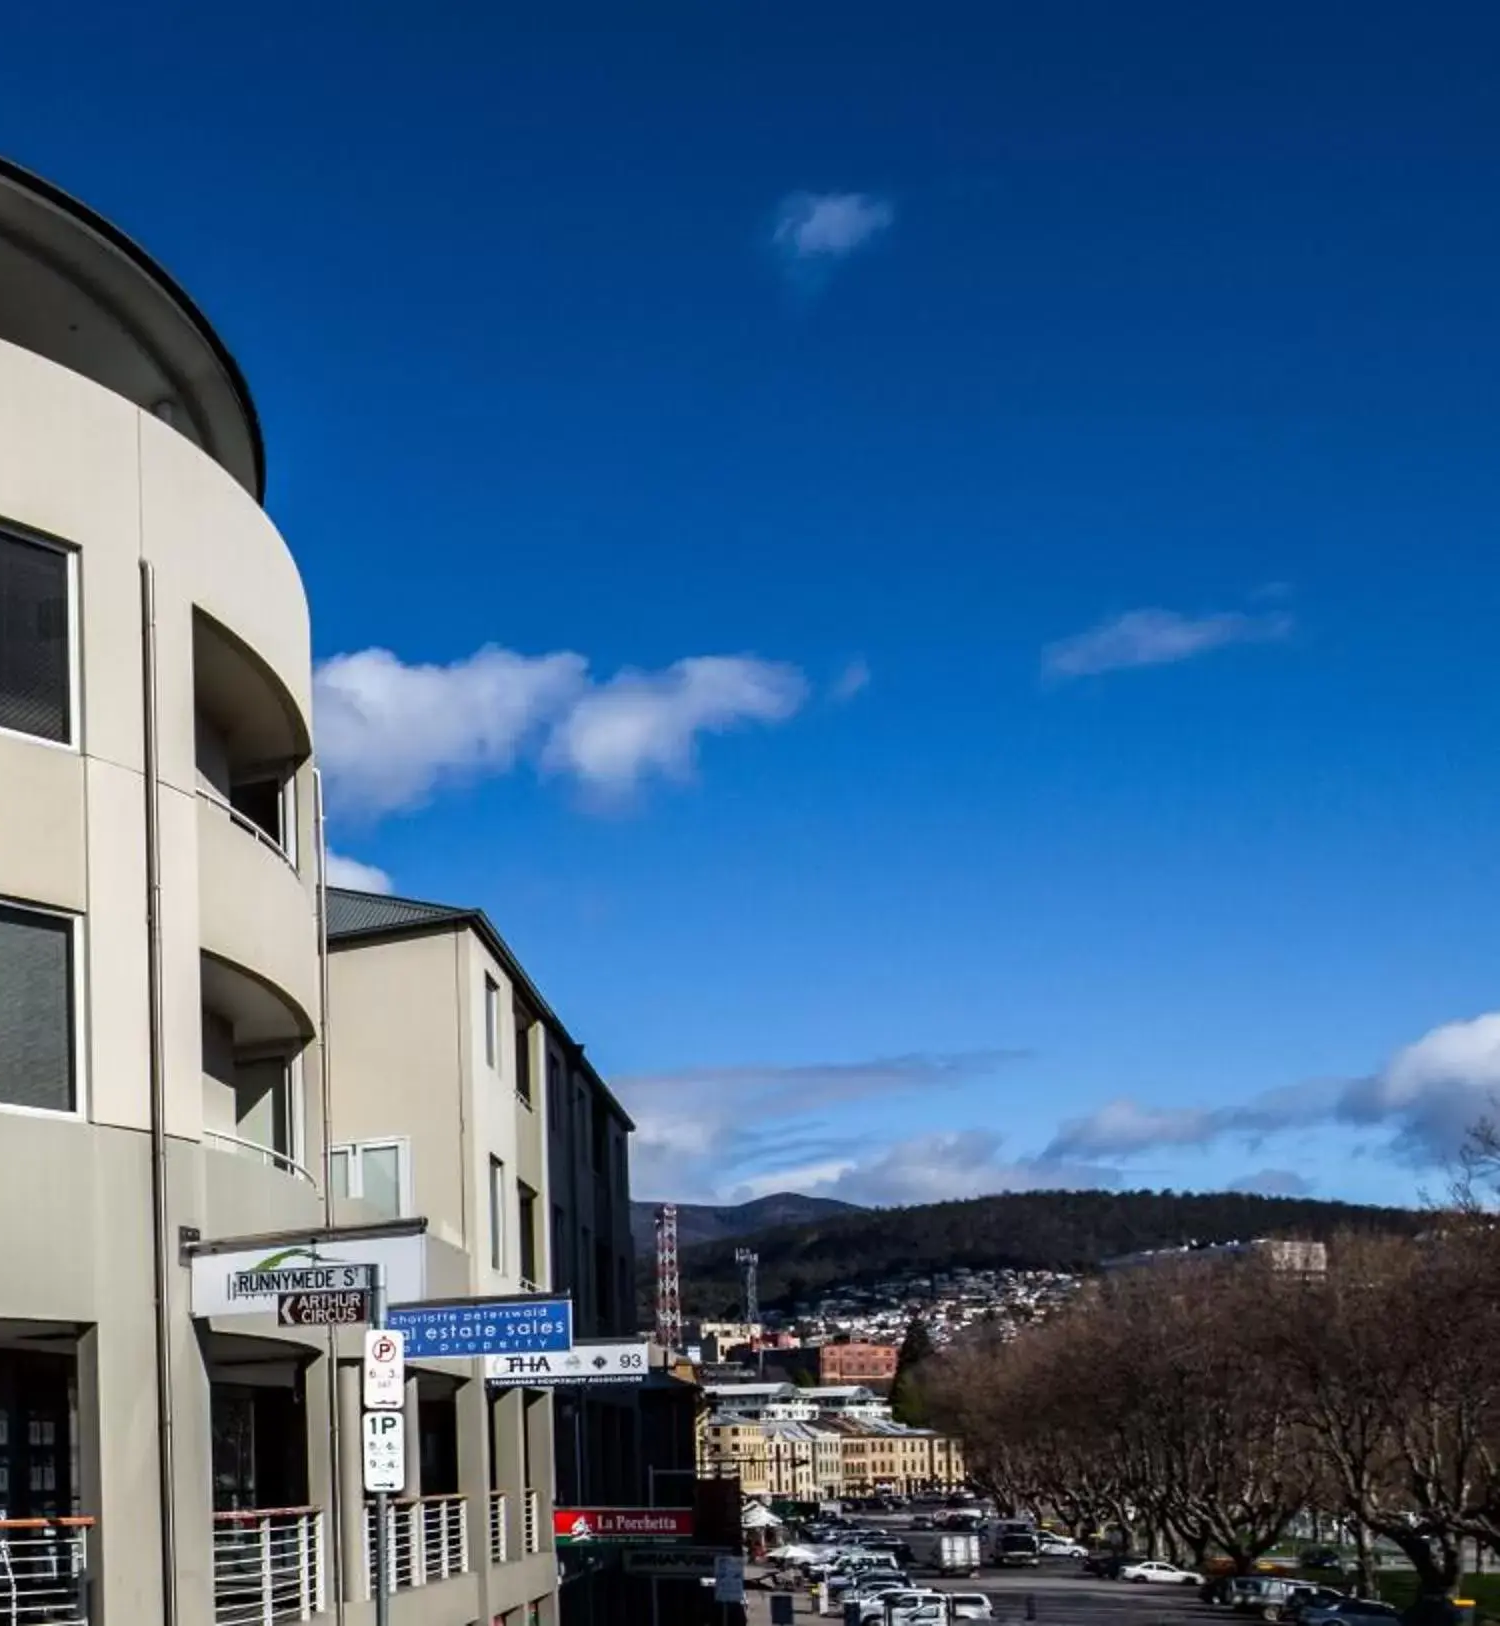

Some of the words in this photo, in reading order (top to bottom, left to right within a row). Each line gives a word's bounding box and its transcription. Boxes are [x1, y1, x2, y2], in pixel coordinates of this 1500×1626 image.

[238, 1269, 335, 1293] RUNNYMEDE
[297, 1293, 361, 1308] ARTHUR
[301, 1308, 357, 1323] CIRCUS
[425, 1323, 497, 1340] estate
[506, 1319, 565, 1336] sales
[440, 1338, 548, 1352] property
[505, 1356, 552, 1373] THA
[619, 1353, 643, 1369] 93
[369, 1416, 397, 1435] 1P
[597, 1515, 613, 1530] La
[616, 1514, 677, 1531] Porchetta
